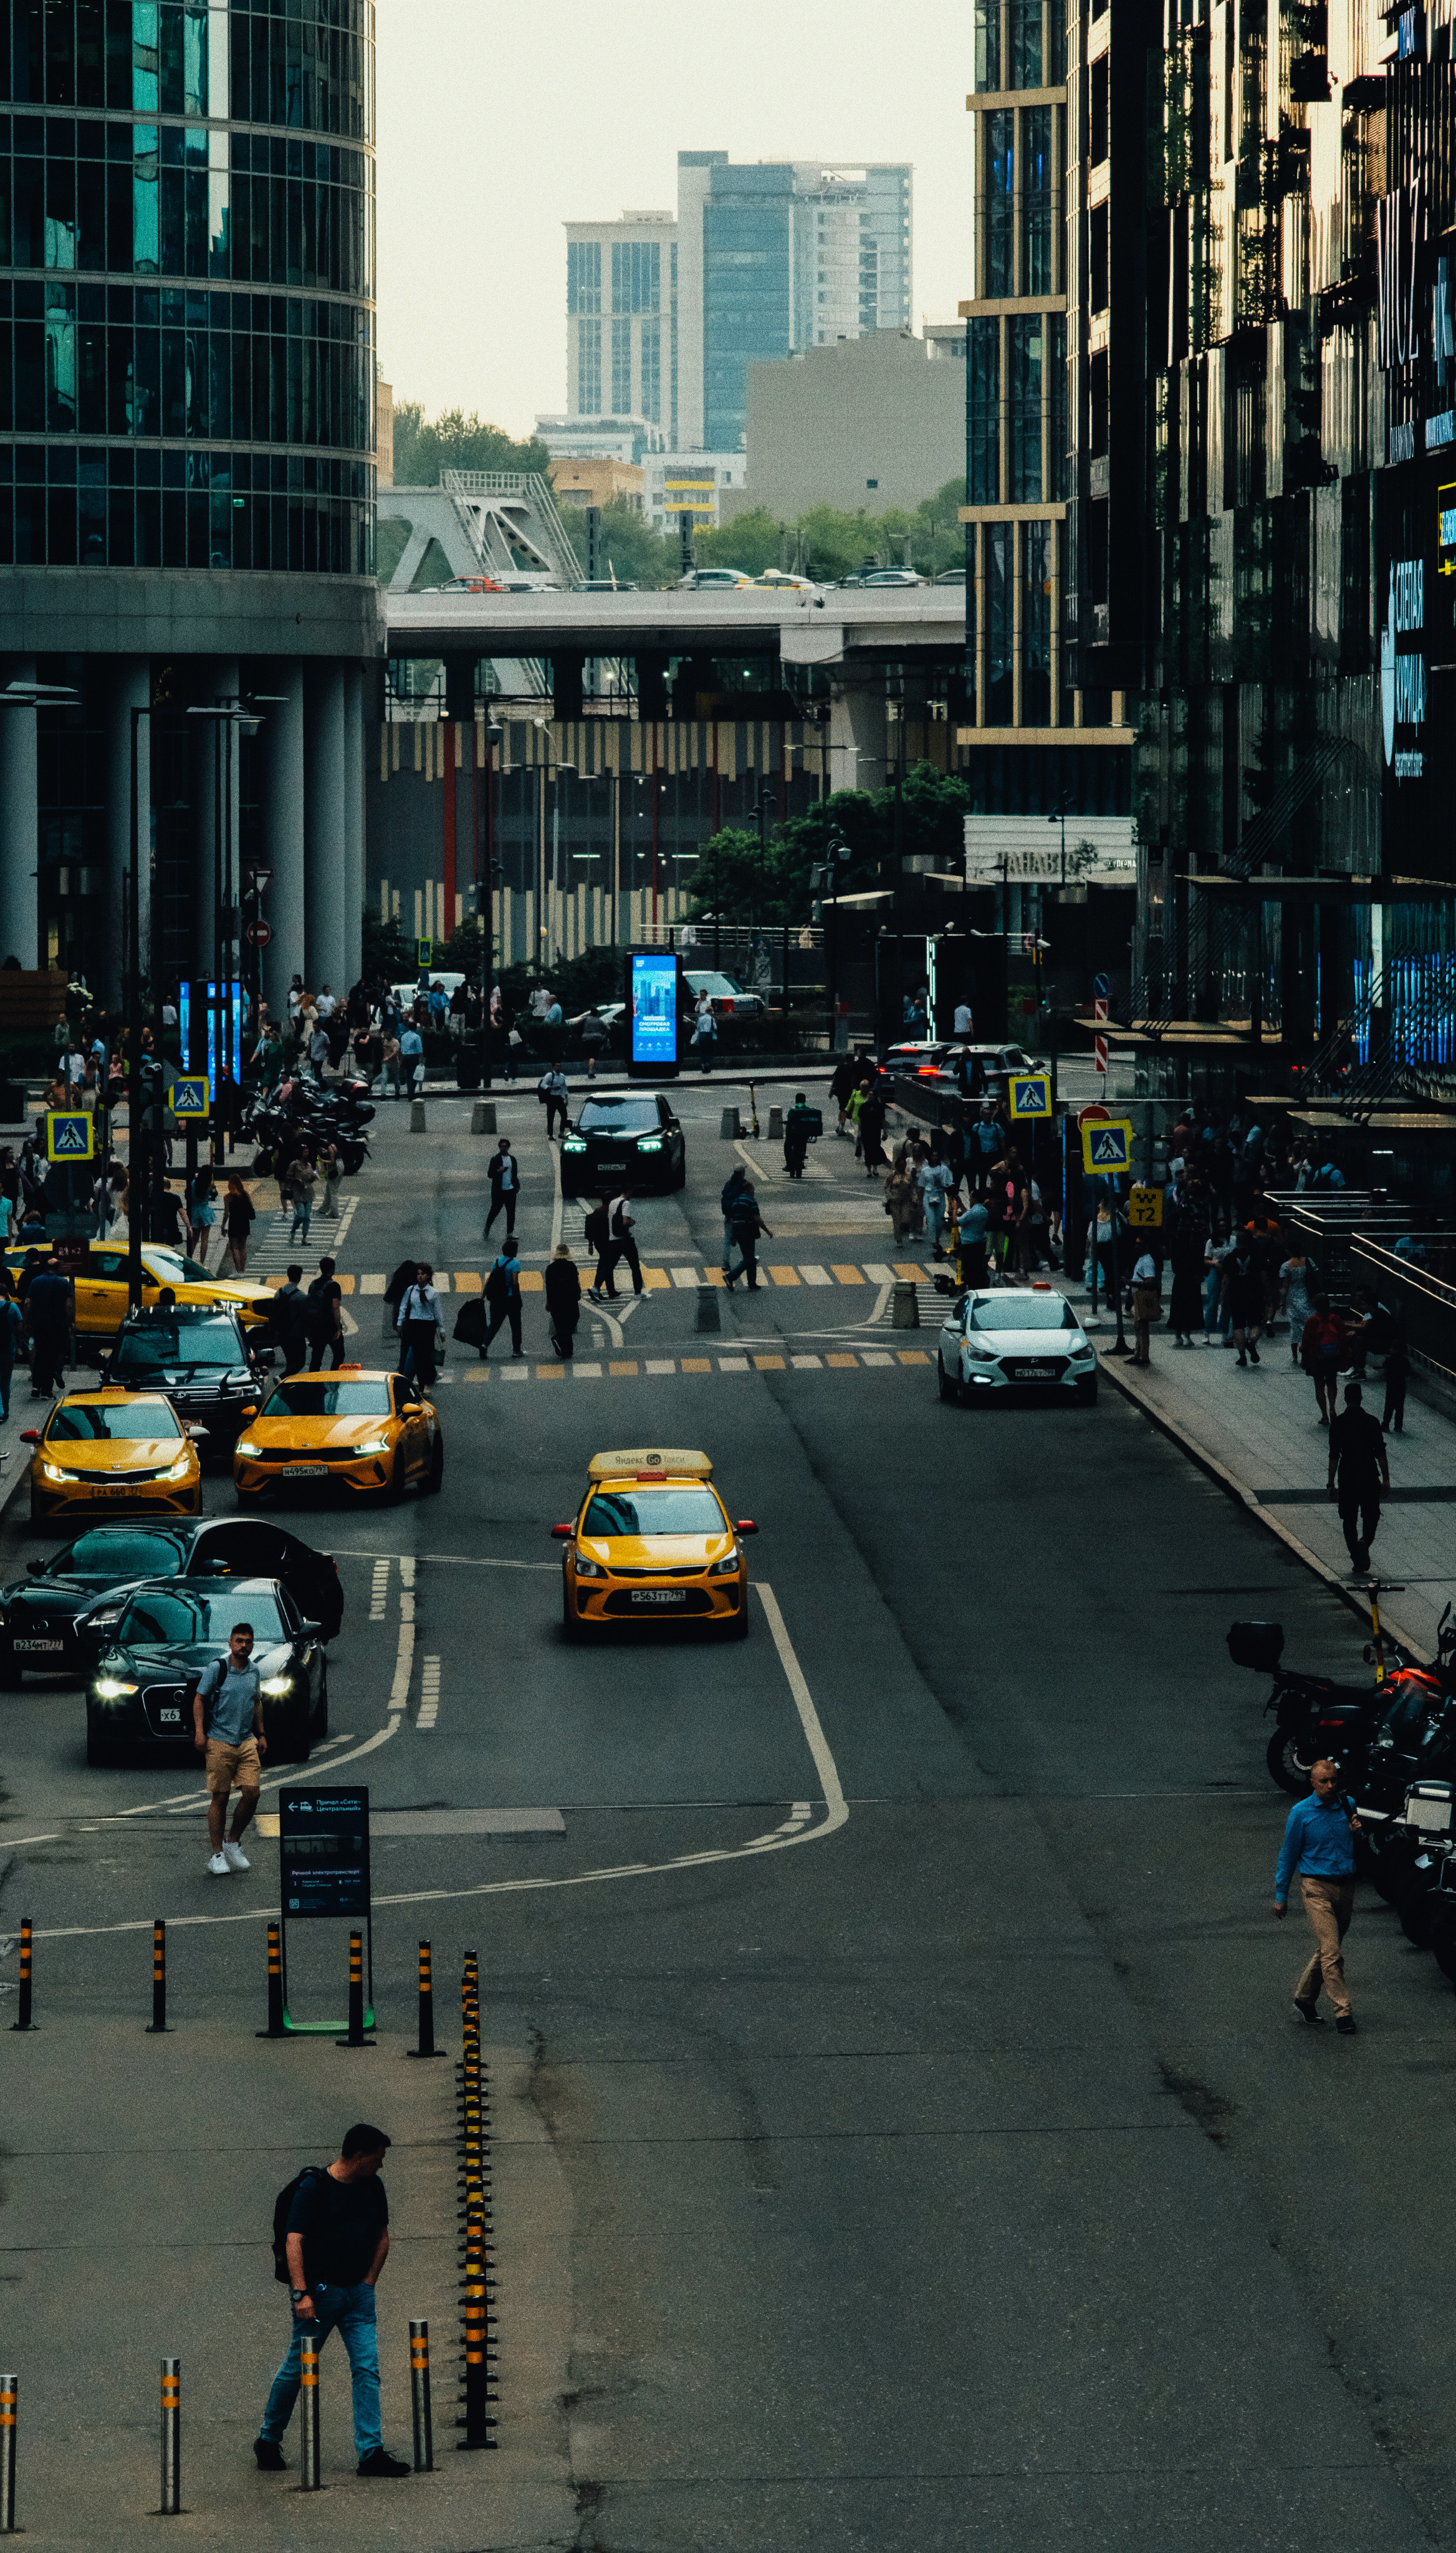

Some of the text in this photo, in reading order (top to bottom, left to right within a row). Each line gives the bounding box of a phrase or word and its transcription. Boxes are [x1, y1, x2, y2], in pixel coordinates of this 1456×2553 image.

[1389, 421, 1415, 463] DIAMONDS
[1396, 559, 1424, 632] СЛЕПАЯ
[1396, 653, 1424, 735] КУРИЦА
[1136, 1207, 1155, 1222] T2
[615, 1455, 644, 1465] Яндекс
[648, 1454, 659, 1464] Go
